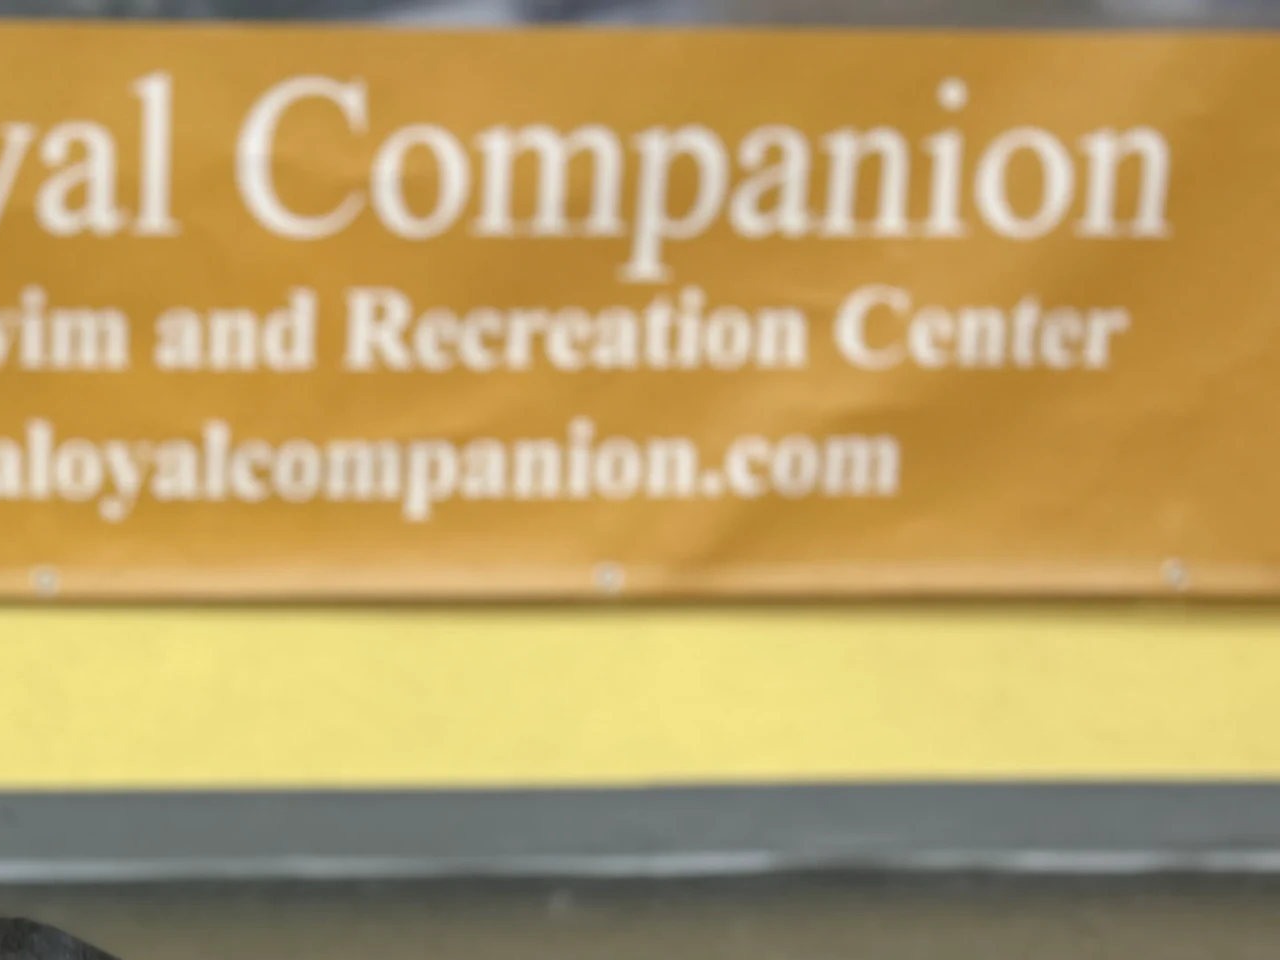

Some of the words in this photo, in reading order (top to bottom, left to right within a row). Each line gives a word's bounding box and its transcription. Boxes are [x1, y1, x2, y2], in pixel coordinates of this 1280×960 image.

[234, 75, 1173, 284] Companion
[153, 286, 318, 372] and
[343, 285, 810, 372] Recreation
[832, 284, 1130, 371] Center
